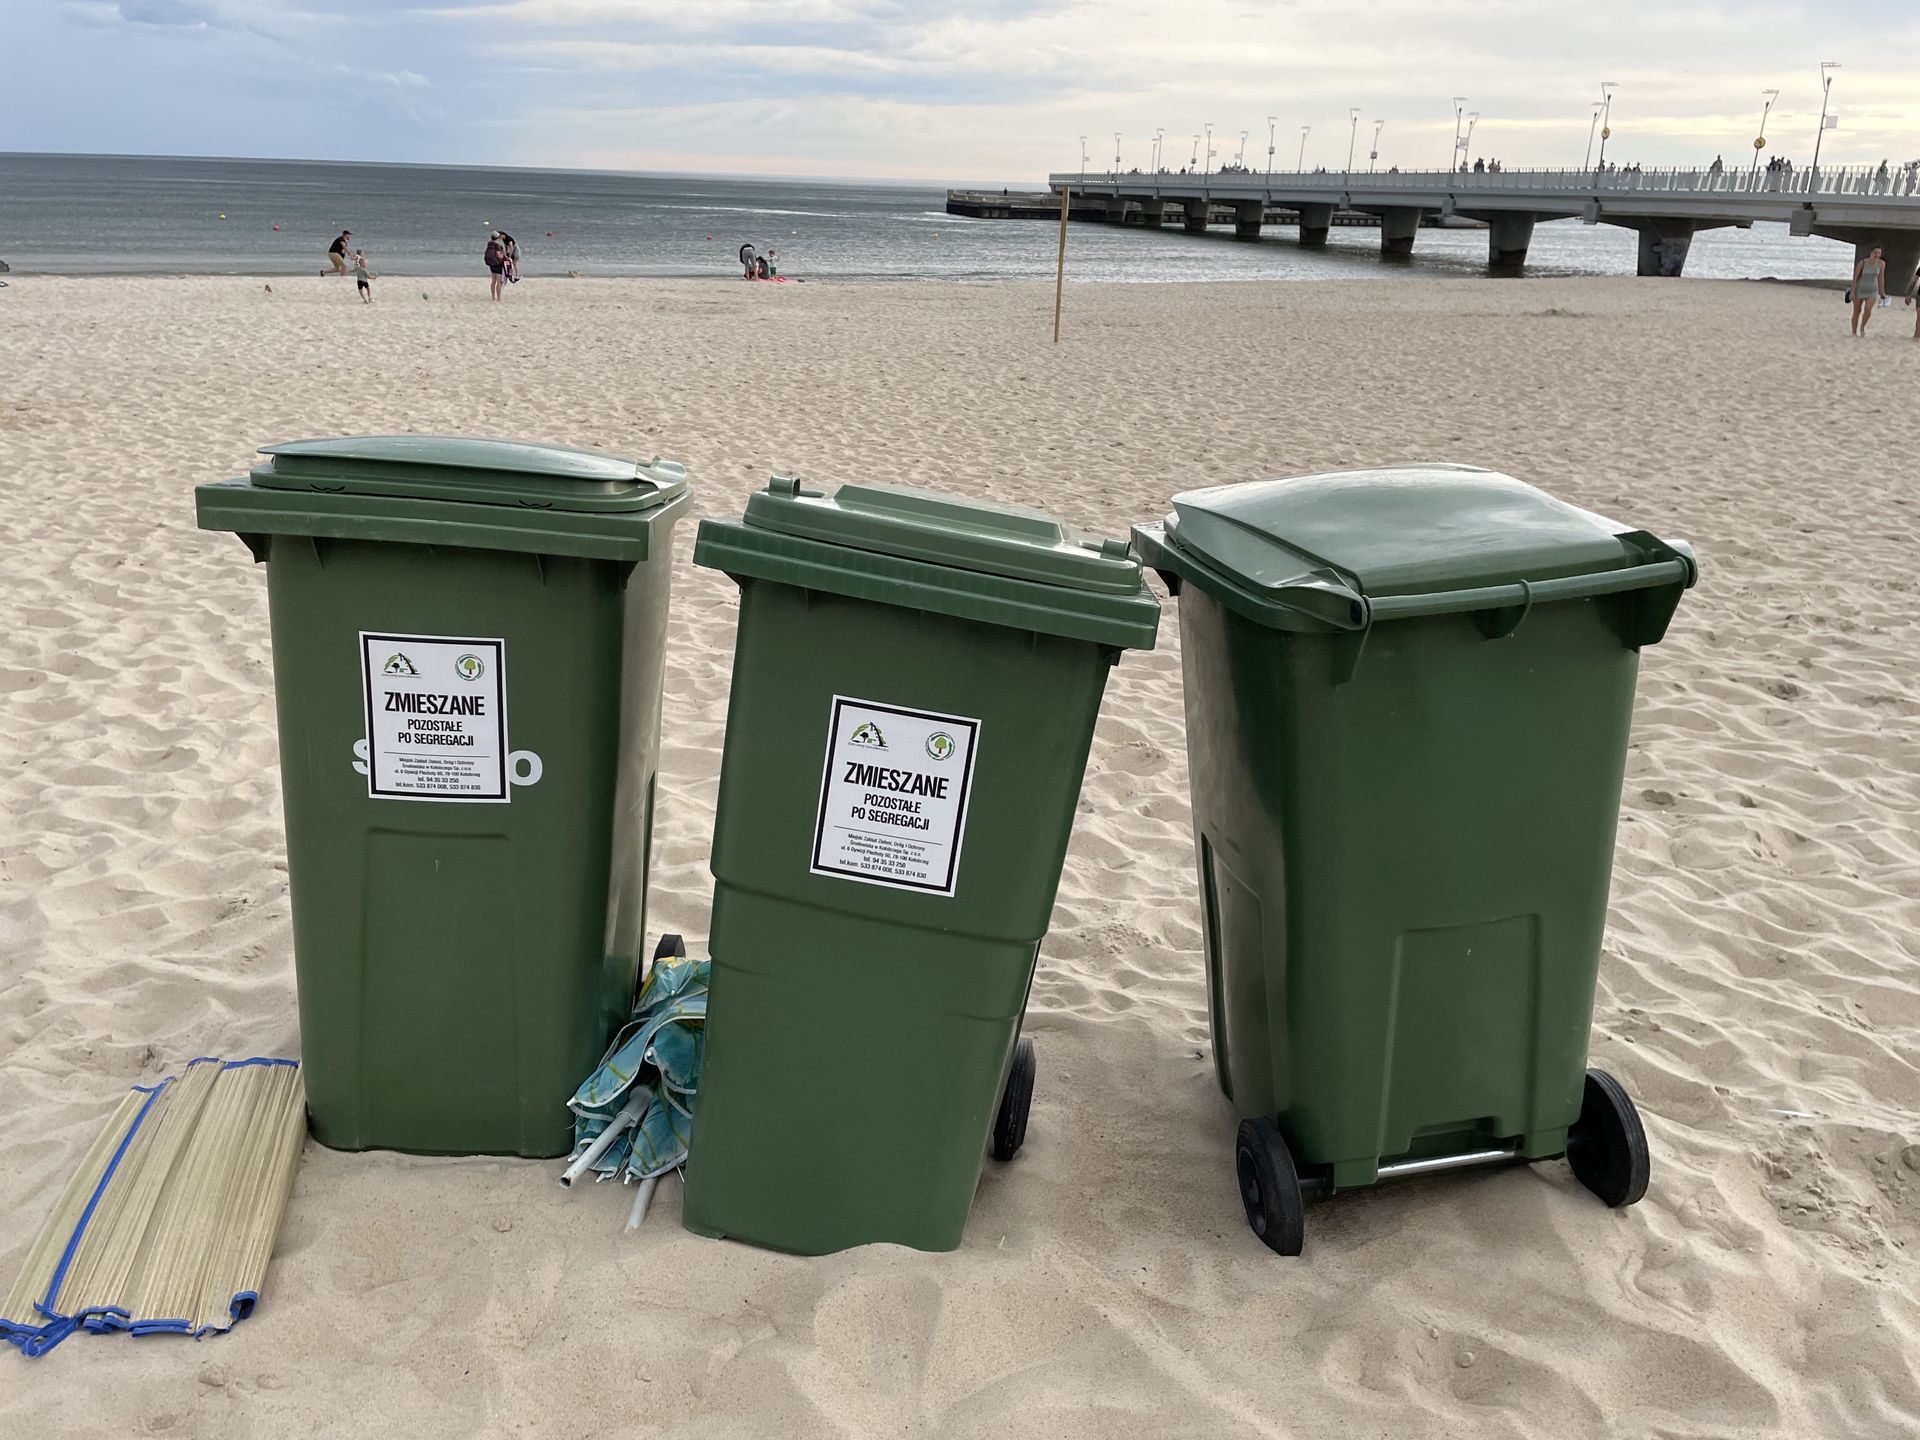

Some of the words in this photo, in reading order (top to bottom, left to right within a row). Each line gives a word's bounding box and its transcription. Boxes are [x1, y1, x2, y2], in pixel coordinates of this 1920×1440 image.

[384, 691, 485, 716] ZMIESZANE
[408, 719, 462, 732] POZOSTAŁE
[398, 732, 411, 743] PO
[414, 733, 474, 746] SEGREGACJI
[844, 761, 949, 799] ZMIESZANE
[864, 793, 922, 814] POZOSTAŁE
[851, 806, 866, 819] PO
[868, 809, 929, 830] SEGREGACJI
